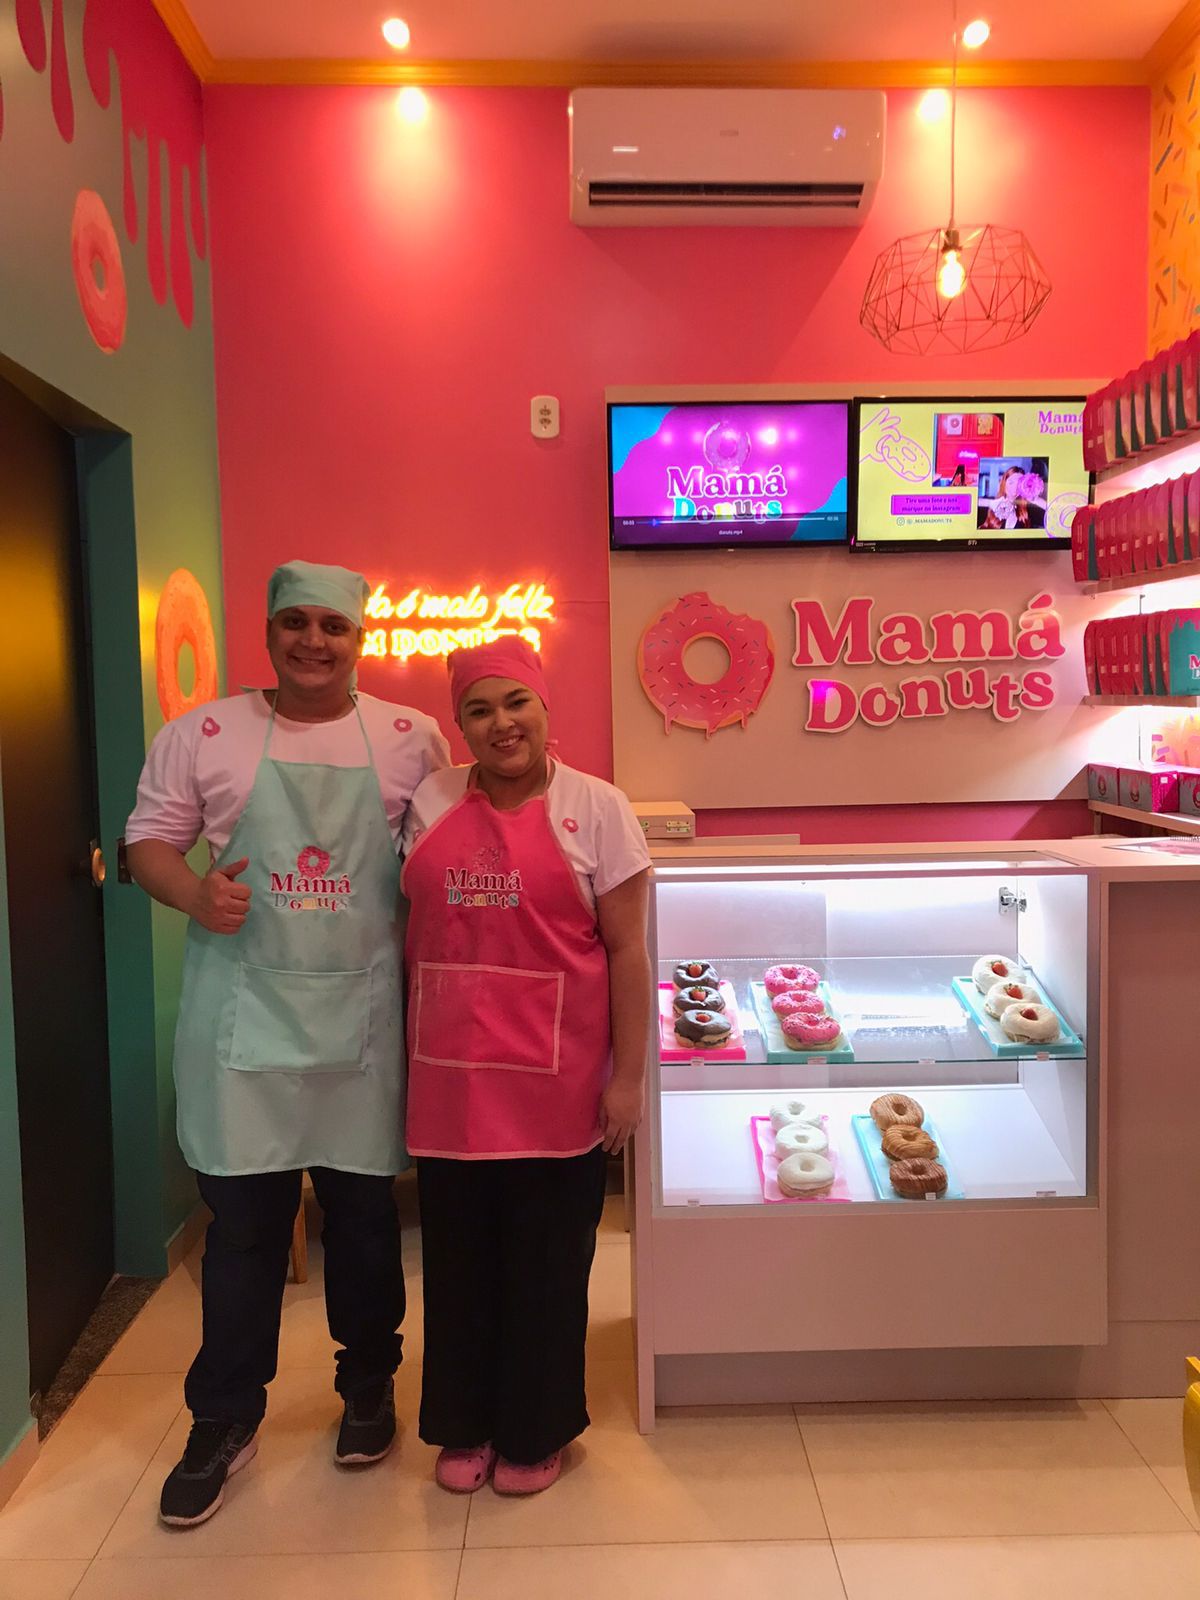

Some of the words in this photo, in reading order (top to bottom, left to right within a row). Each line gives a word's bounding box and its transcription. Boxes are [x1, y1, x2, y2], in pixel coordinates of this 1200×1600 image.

[667, 465, 787, 498] Mamá
[672, 496, 782, 524] Donuts
[792, 592, 1066, 666] Mamá
[805, 667, 1055, 733] Donuts
[270, 871, 351, 895] Mamá
[445, 867, 522, 891] Mamá
[272, 893, 350, 912] Donuts
[446, 888, 520, 908] Donuts
